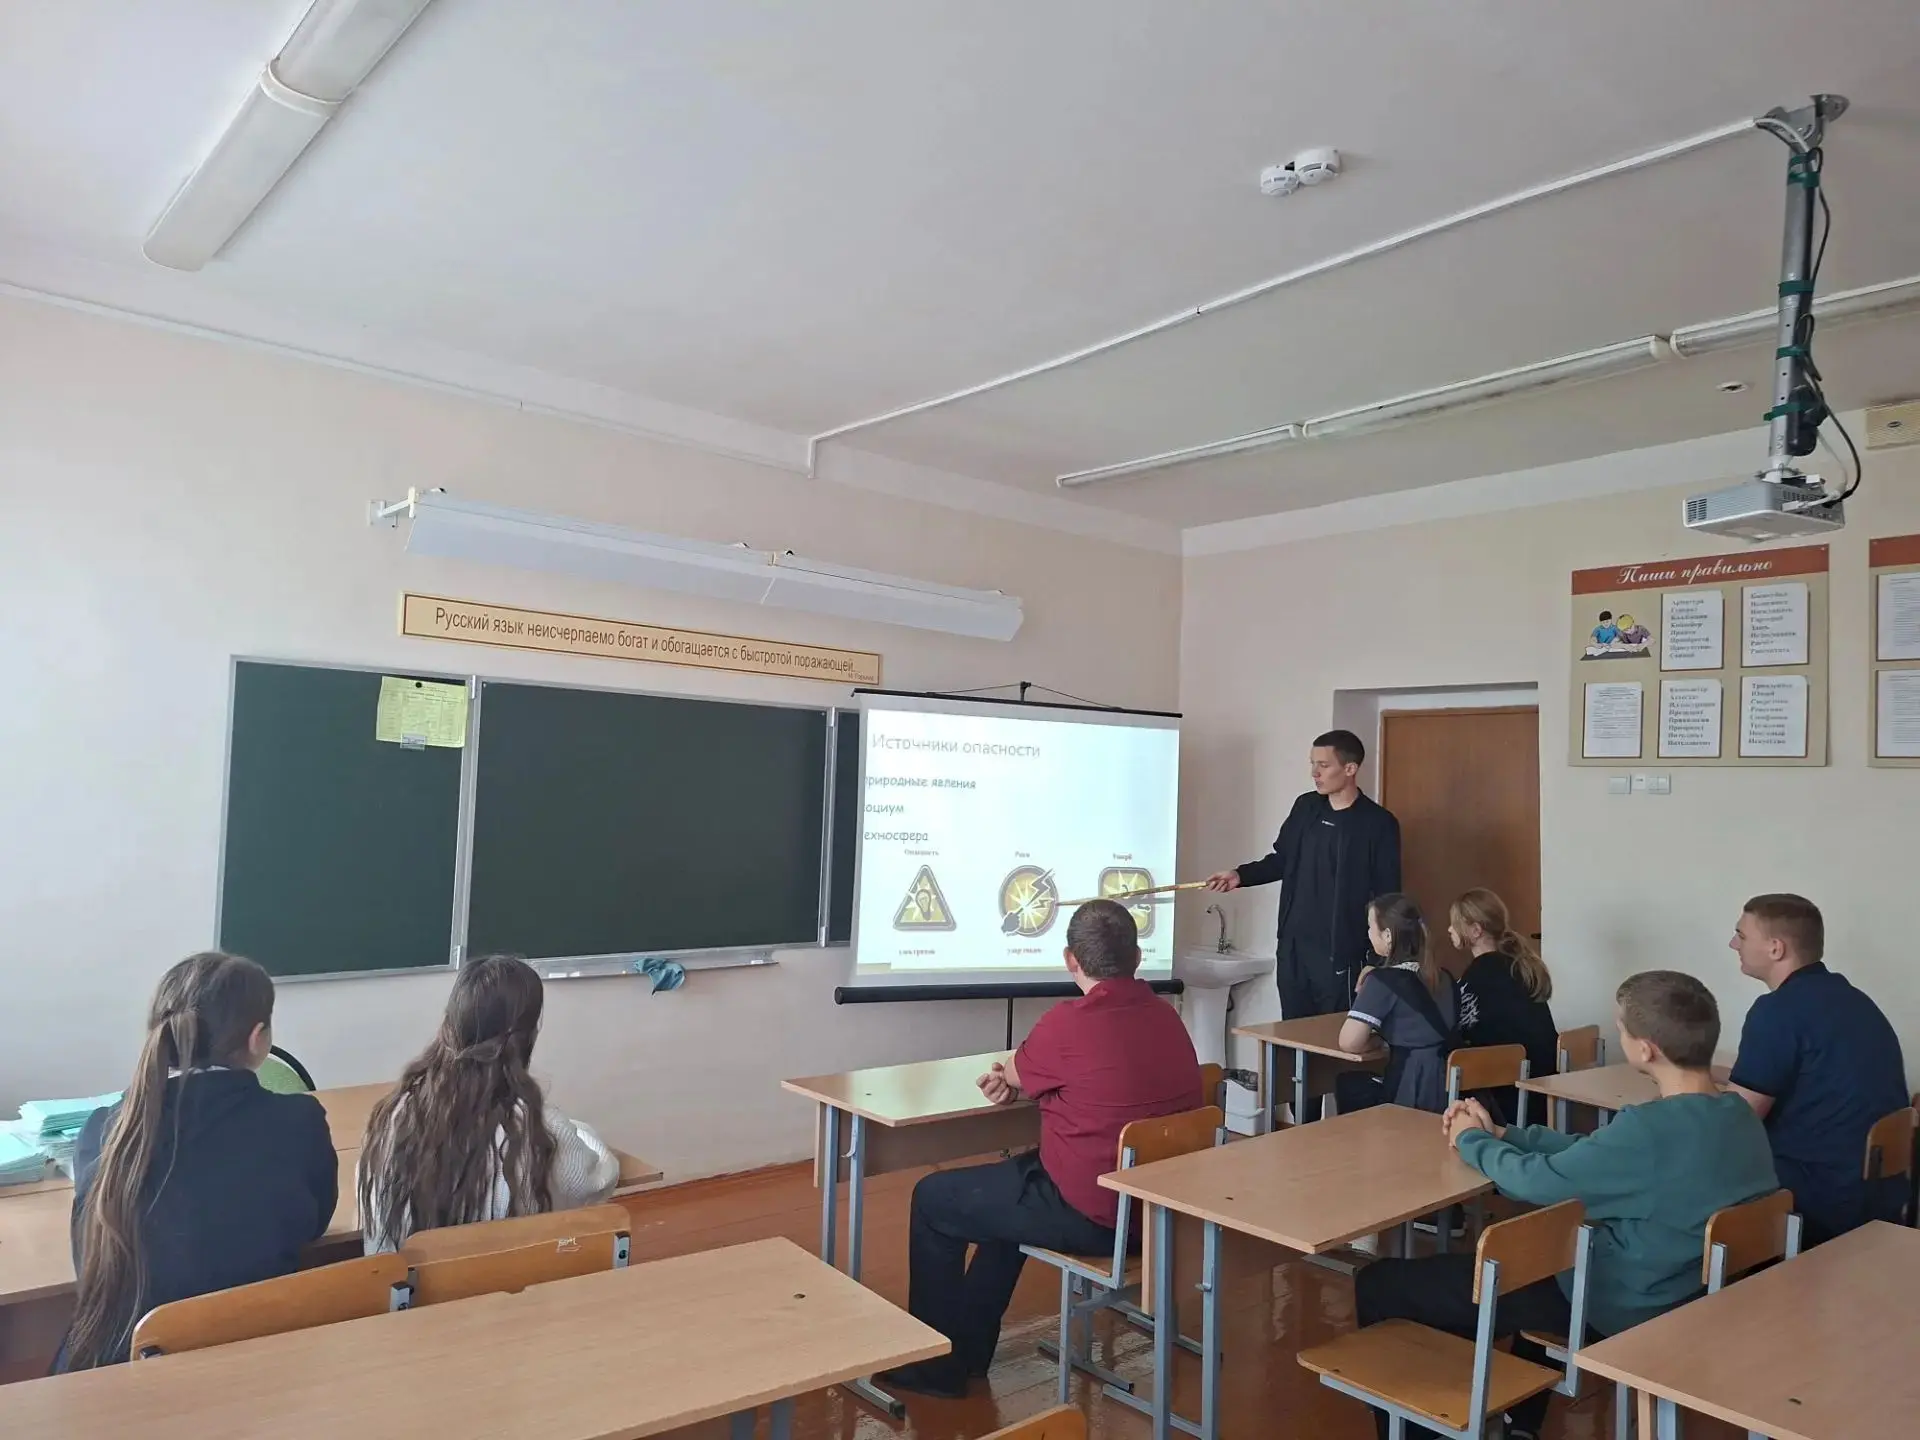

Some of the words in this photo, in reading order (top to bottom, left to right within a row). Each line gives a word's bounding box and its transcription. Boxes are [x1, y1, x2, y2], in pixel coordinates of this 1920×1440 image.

[1616, 566, 1676, 583] Пиши
[1681, 558, 1772, 584] правильно
[435, 607, 489, 631] Русский
[493, 619, 524, 635] язык
[527, 623, 615, 645] неисчерпаемо
[618, 630, 648, 649] богат
[651, 638, 659, 650] и
[661, 636, 730, 658] обогащается
[732, 647, 738, 660] с
[740, 644, 791, 665] быстротой
[872, 734, 958, 753] Источники
[962, 742, 1040, 758] опасности
[931, 779, 976, 789] явления
[863, 803, 904, 816] оциум
[864, 832, 928, 844] ехносфера
